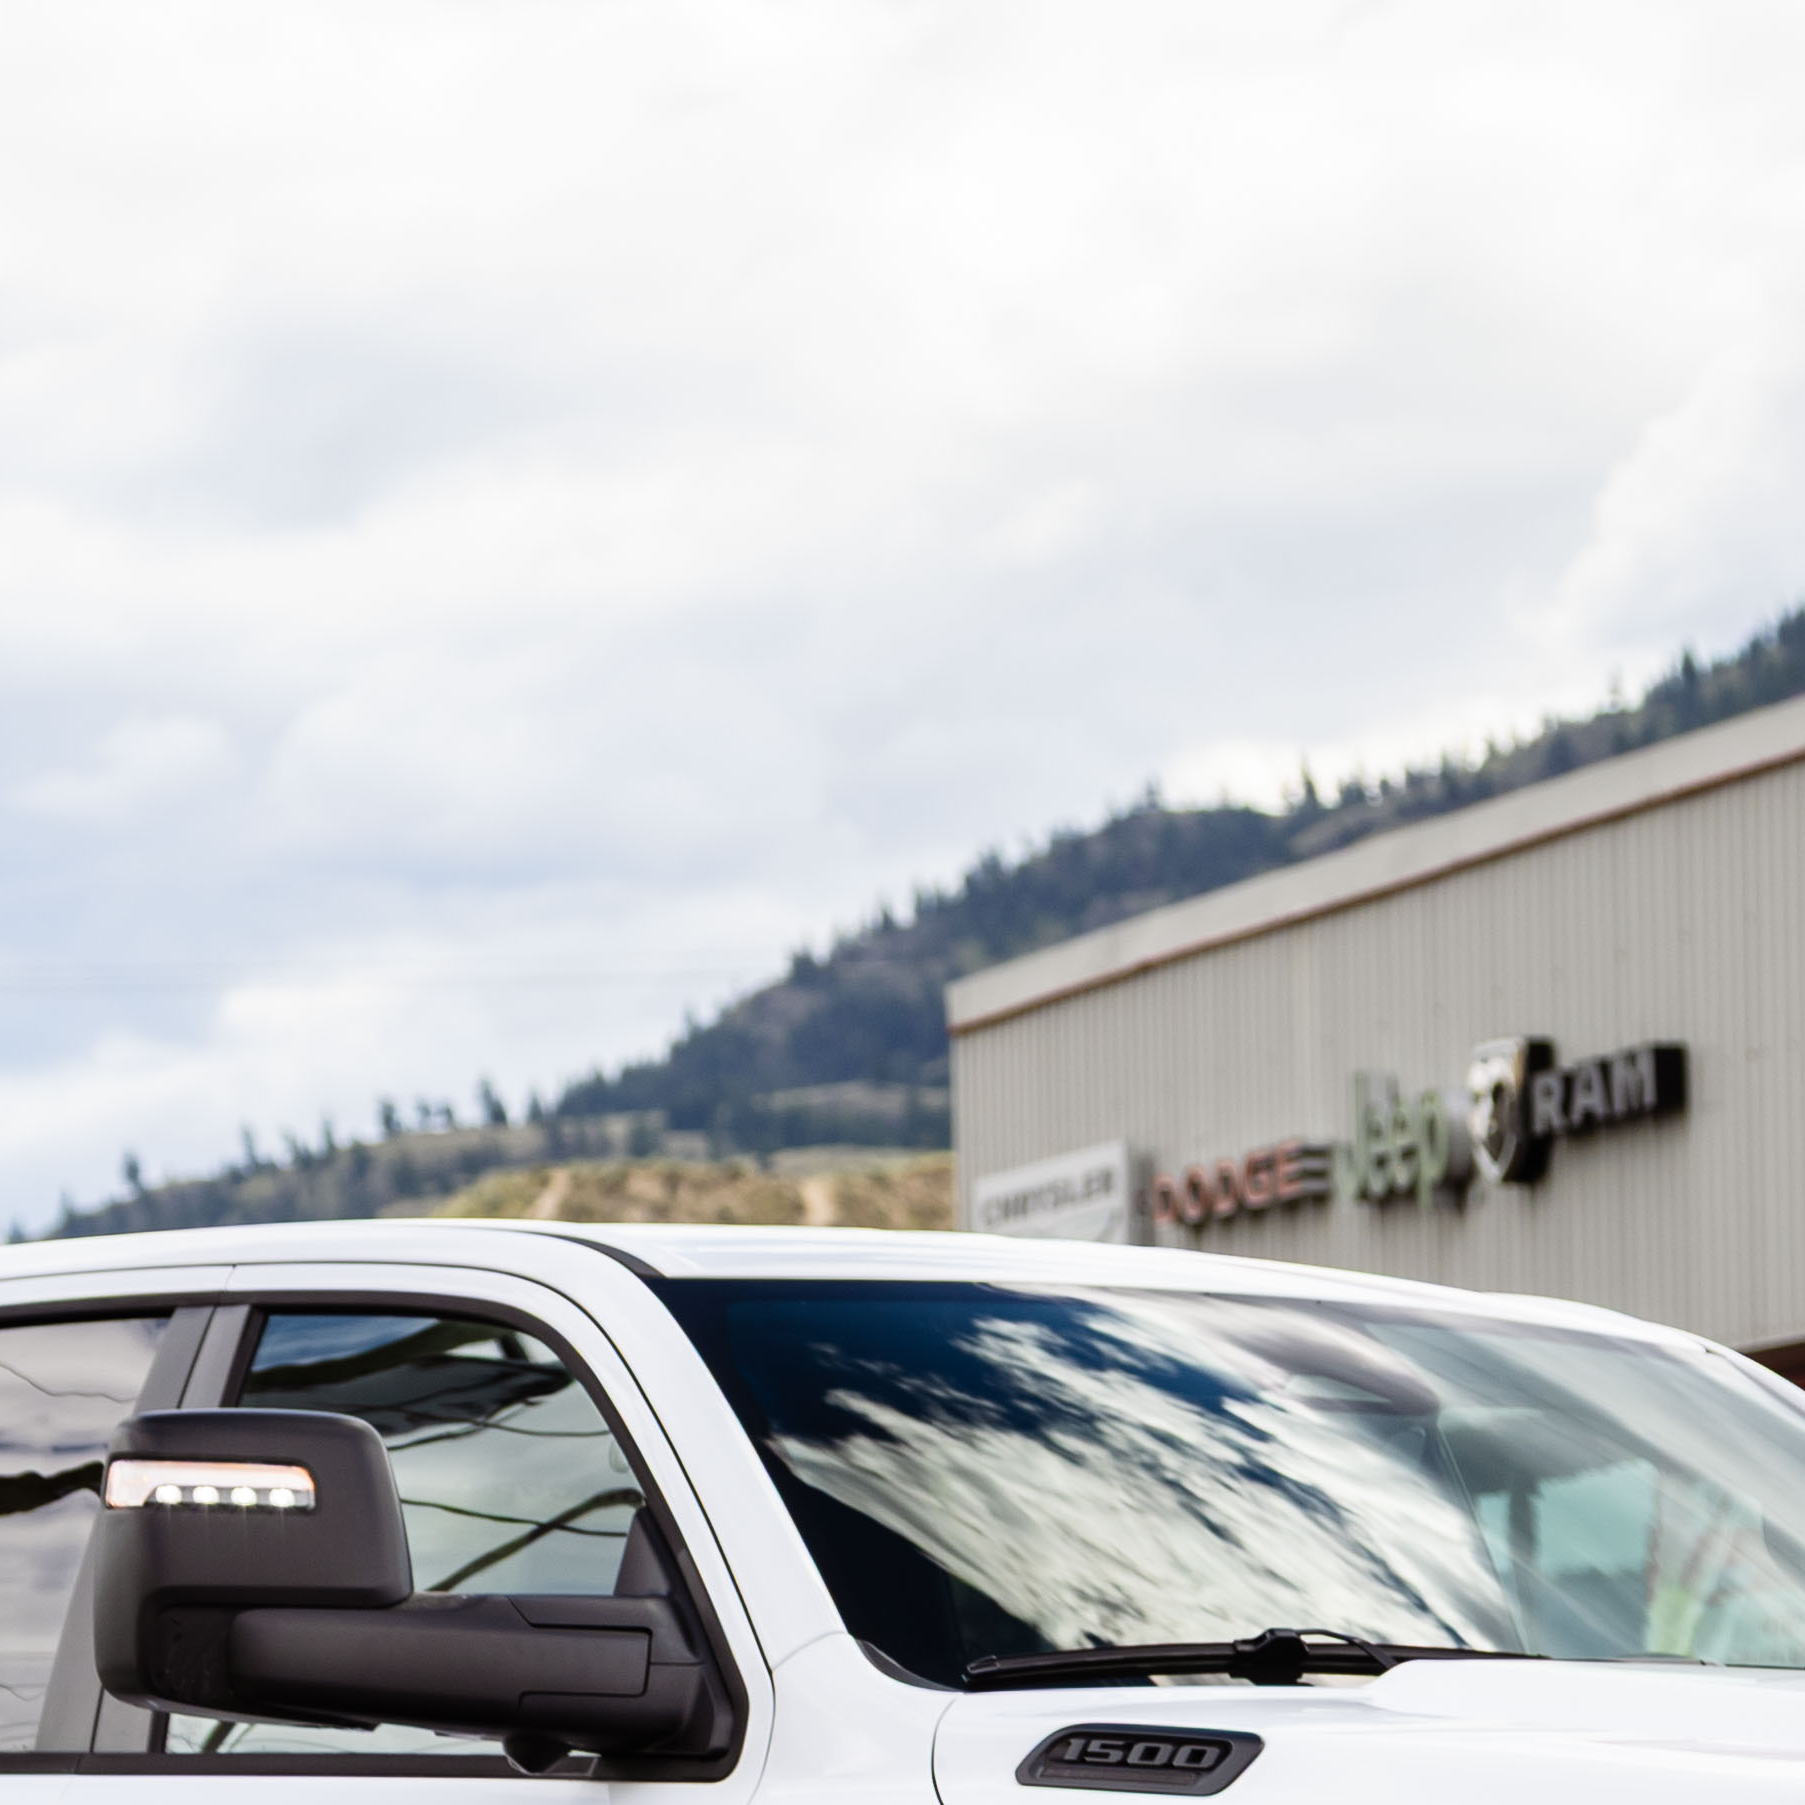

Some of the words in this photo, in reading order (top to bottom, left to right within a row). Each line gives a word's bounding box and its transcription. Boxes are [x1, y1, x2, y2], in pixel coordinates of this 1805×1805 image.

[1531, 1047, 1656, 1137] RAM
[1152, 1137, 1303, 1228] DODGE
[1332, 1072, 1450, 1210] Jeep
[1063, 1737, 1220, 1769] 1500
